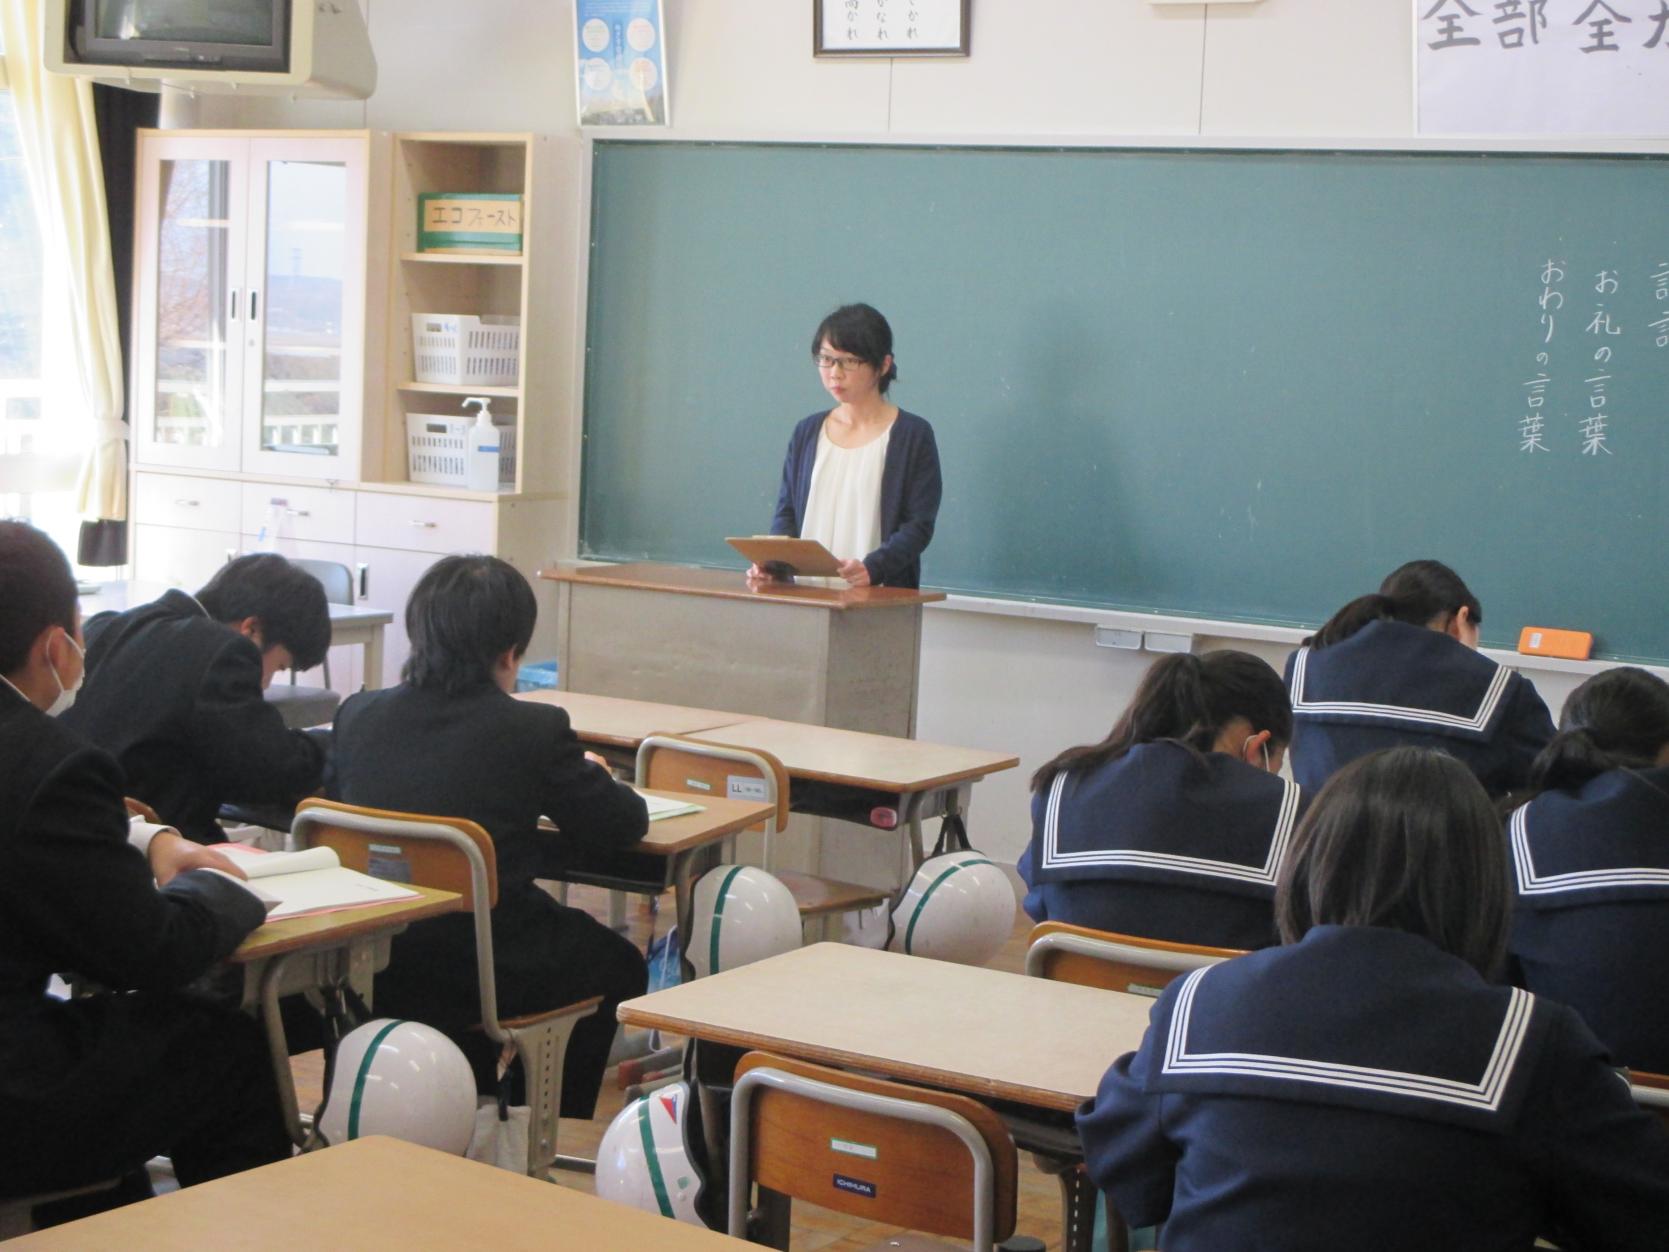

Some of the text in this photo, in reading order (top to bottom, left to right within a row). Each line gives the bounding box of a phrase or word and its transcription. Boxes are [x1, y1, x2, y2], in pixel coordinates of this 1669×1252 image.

[1517, 258, 1566, 454] おわりの言葉
[1578, 269, 1621, 456] お礼の言葉
